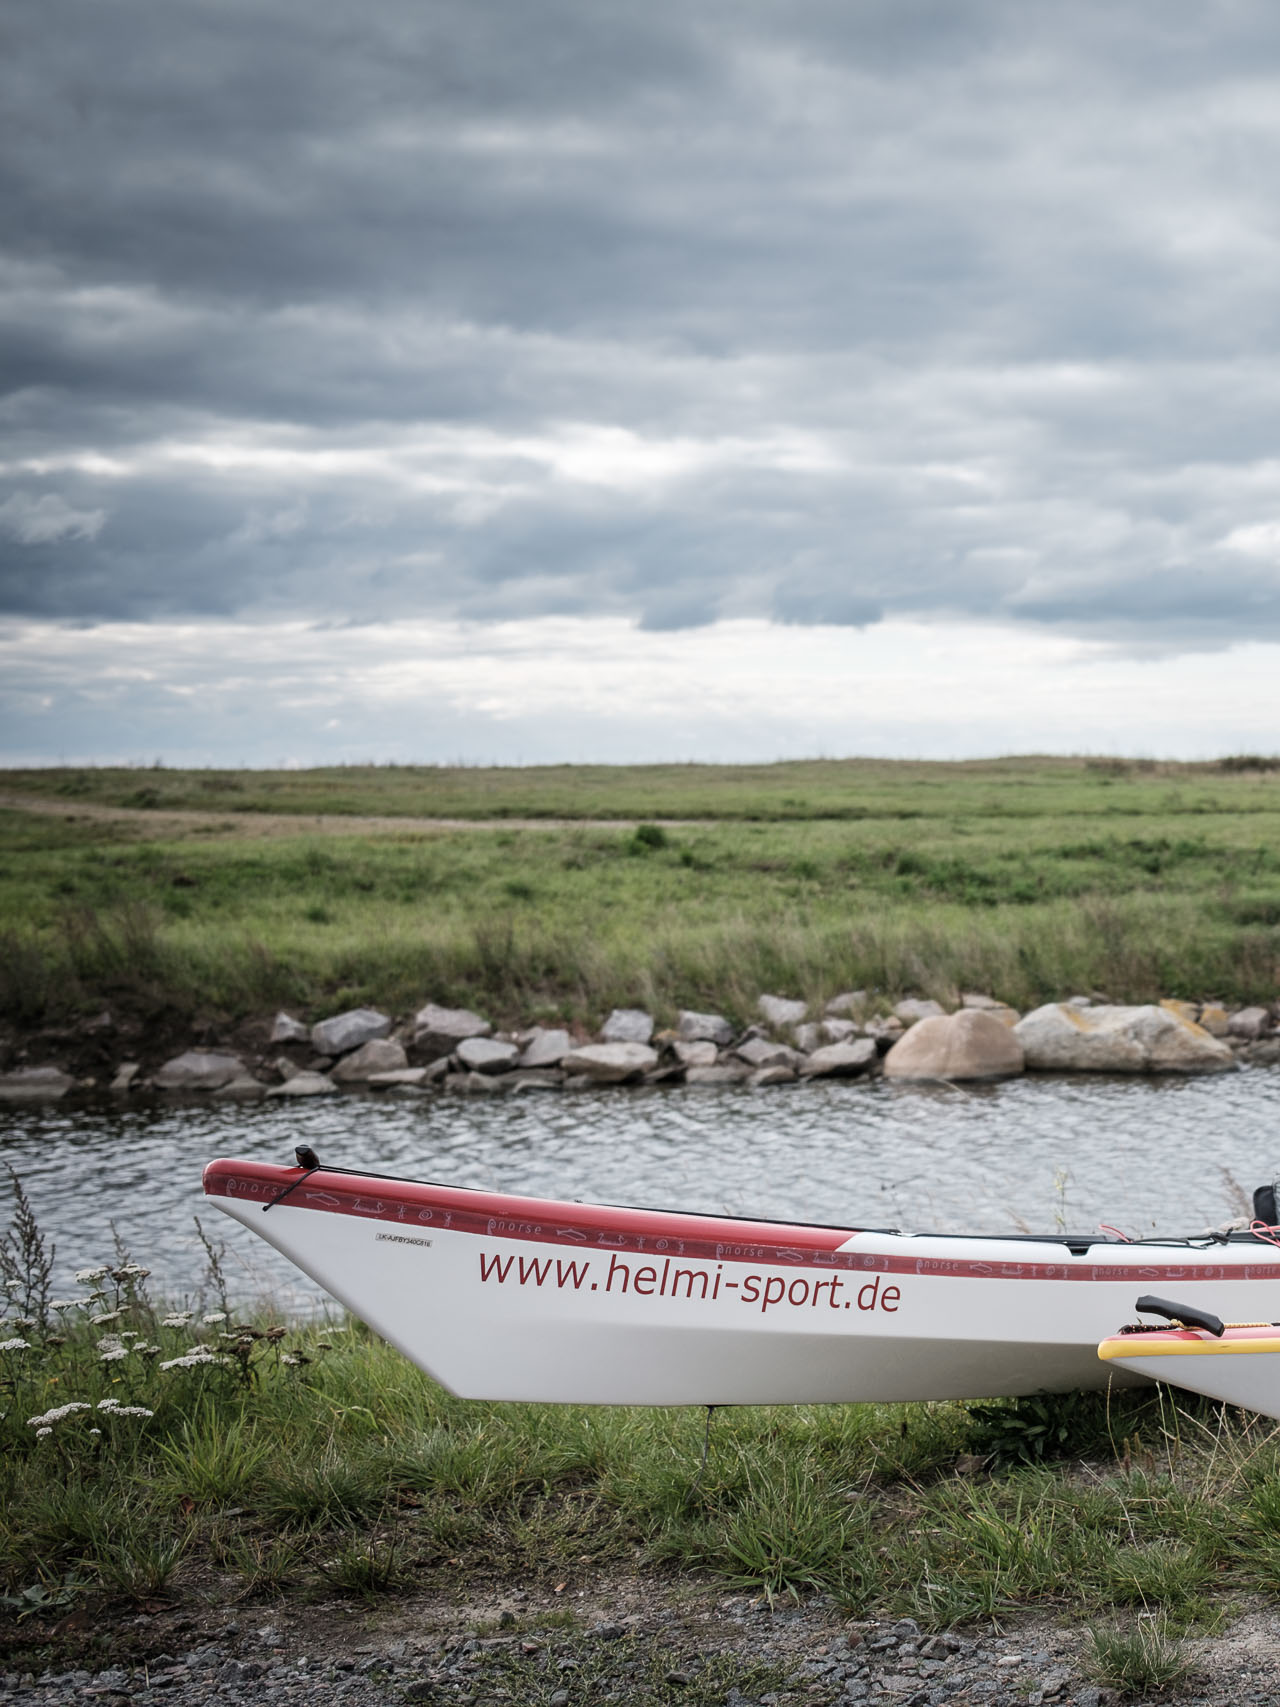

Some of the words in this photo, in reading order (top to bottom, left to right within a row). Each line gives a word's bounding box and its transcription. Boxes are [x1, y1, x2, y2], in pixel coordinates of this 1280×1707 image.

[498, 1220, 542, 1235] norse
[725, 1246, 764, 1257] norse
[479, 1252, 901, 1313] www.helmi-sport.de
